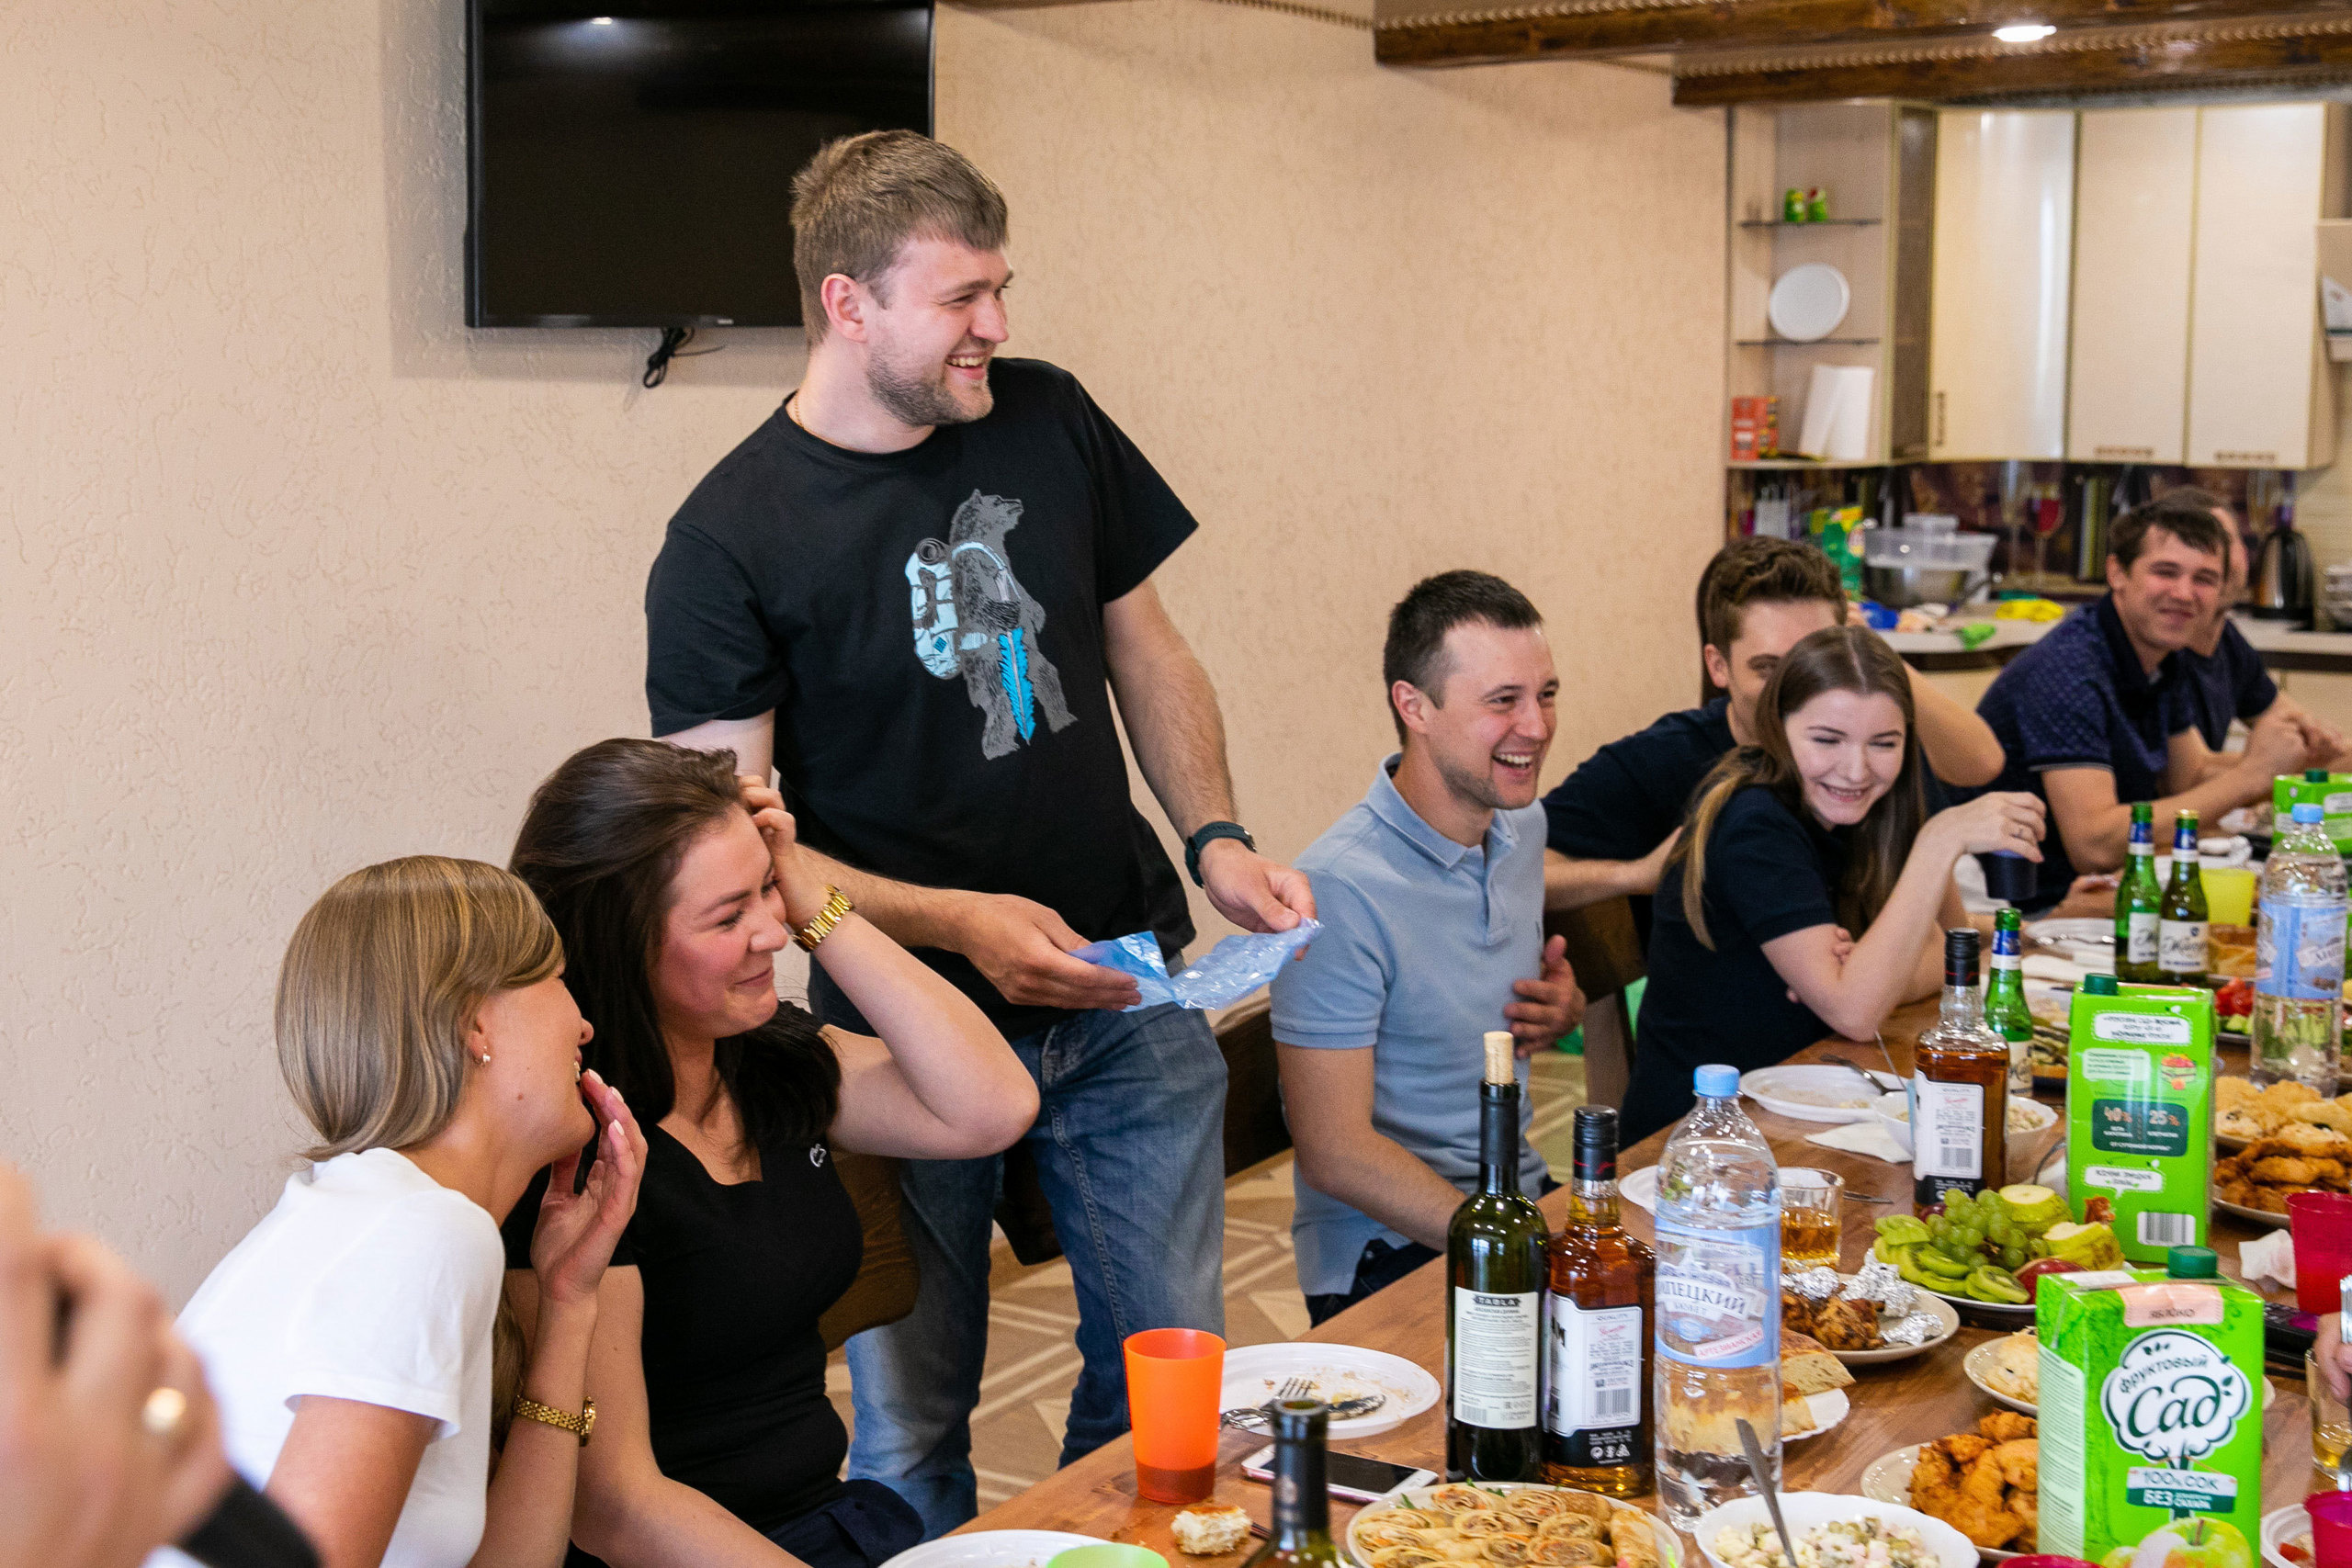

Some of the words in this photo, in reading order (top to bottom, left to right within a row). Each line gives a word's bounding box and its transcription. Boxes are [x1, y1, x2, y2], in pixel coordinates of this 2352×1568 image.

[1477, 1296, 1516, 1306] TABLA
[1657, 1280, 1747, 1314] ПЕЦКИЙ
[2127, 1375, 2221, 1438] Сад
[2185, 1474, 2220, 1491] СОК
[2143, 1488, 2174, 1506] БЕЗ
